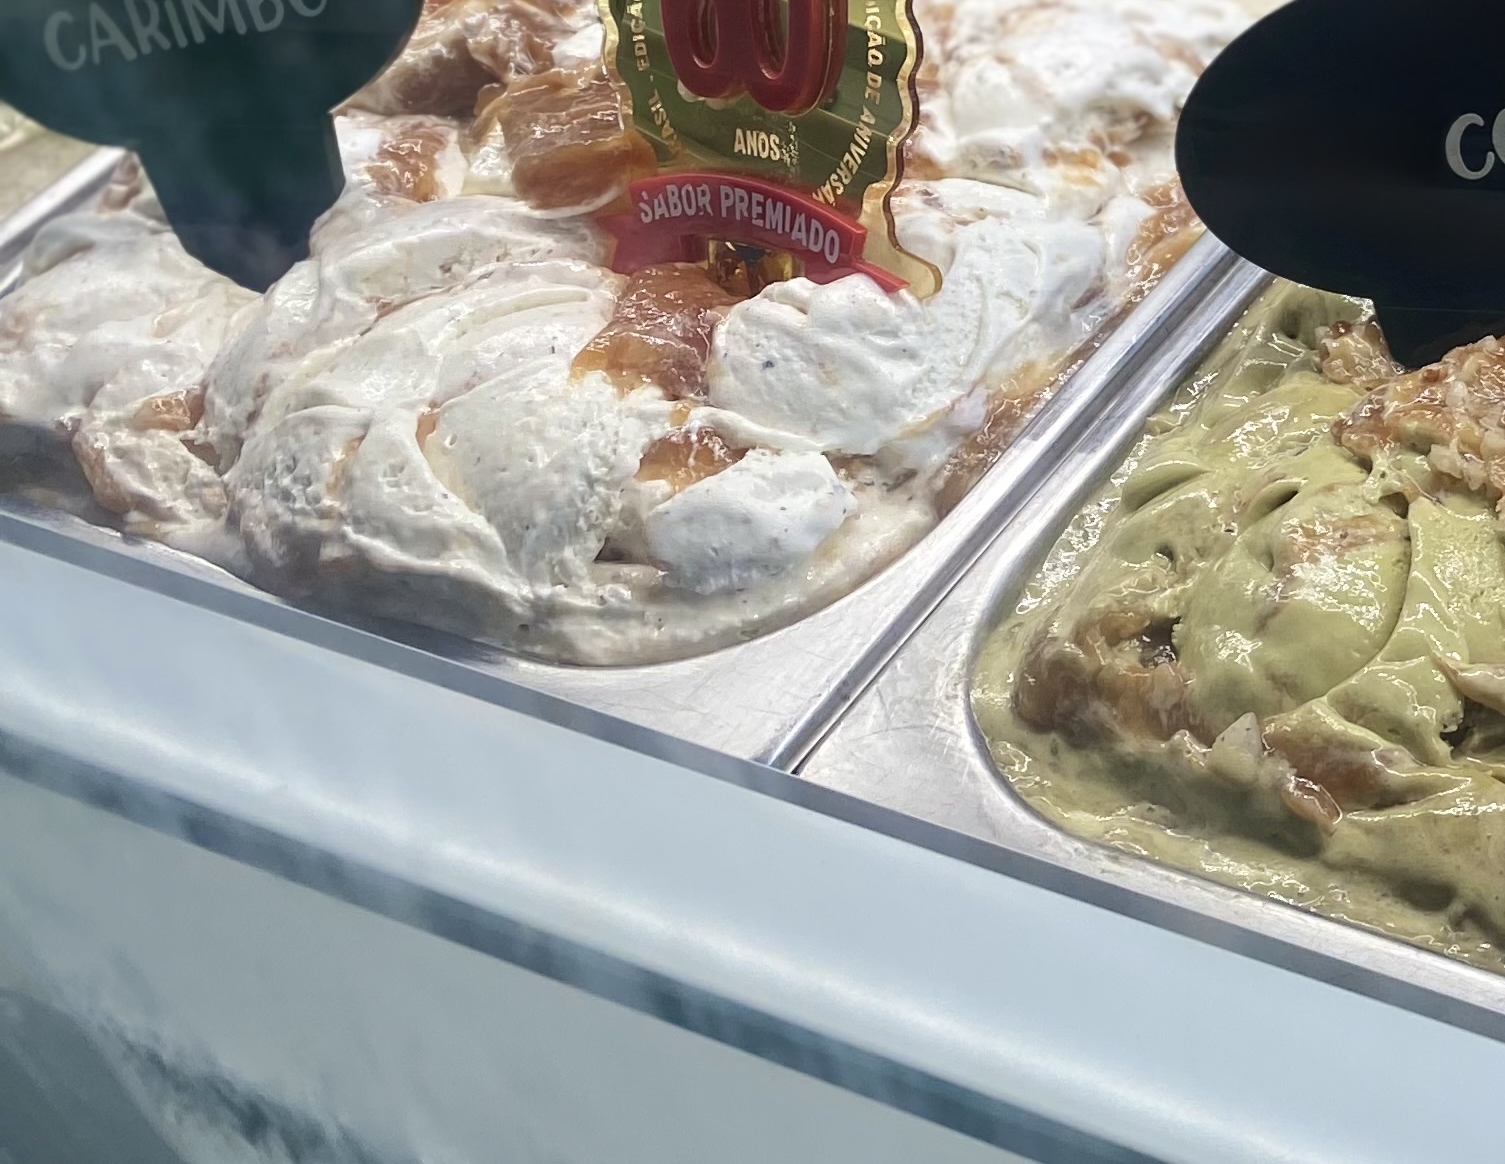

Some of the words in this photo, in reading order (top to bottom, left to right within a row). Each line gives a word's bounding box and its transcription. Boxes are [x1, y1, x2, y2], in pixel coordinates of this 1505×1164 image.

[864, 71, 883, 105] DE
[734, 128, 781, 161] ANOS
[638, 184, 713, 224] SABOR
[720, 185, 840, 264] PREMIADO
